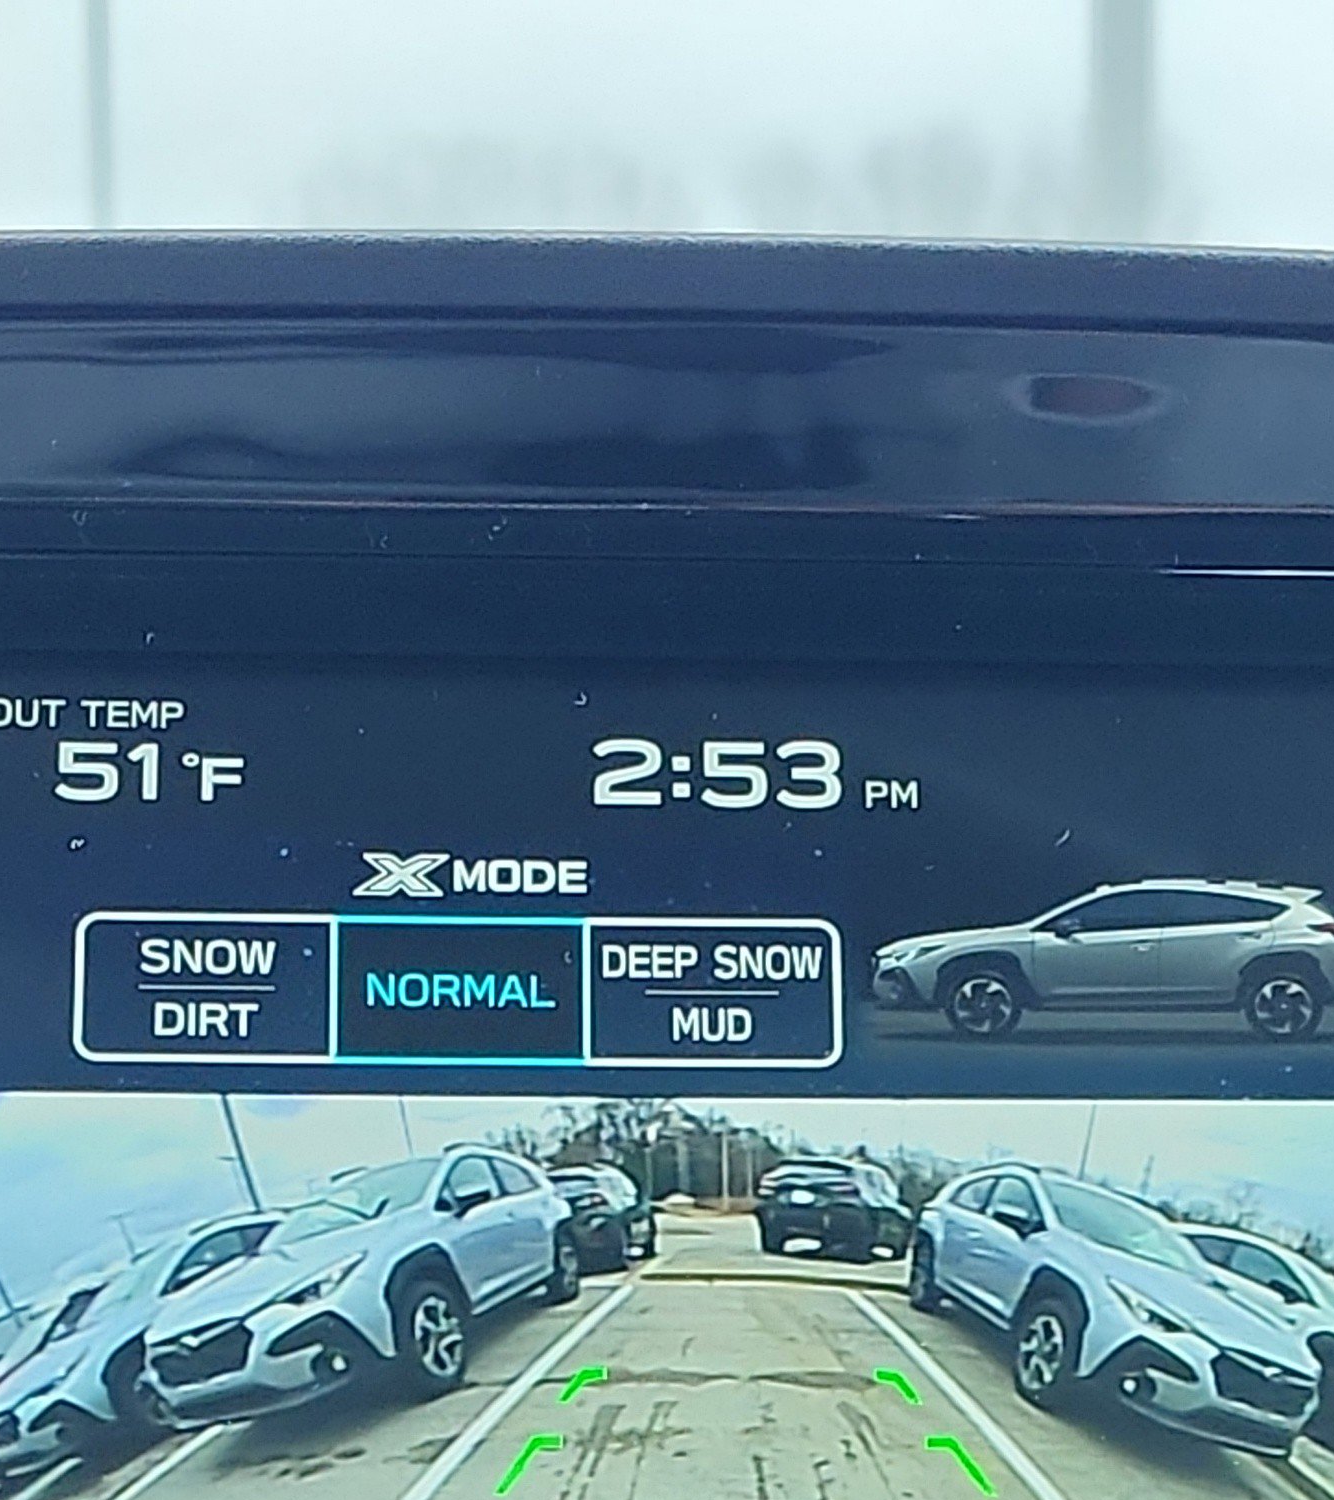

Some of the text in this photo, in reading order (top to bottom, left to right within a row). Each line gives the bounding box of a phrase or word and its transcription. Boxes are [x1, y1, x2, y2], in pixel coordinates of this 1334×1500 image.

[80, 699, 185, 729] TEMP
[592, 738, 919, 809] 2:53 PM
[140, 938, 277, 975] SNOW
[601, 944, 823, 981] DEEP SNOW
[366, 972, 556, 1010] NORMAL
[153, 1001, 260, 1038] DIRT
[672, 1006, 753, 1042] MUD
